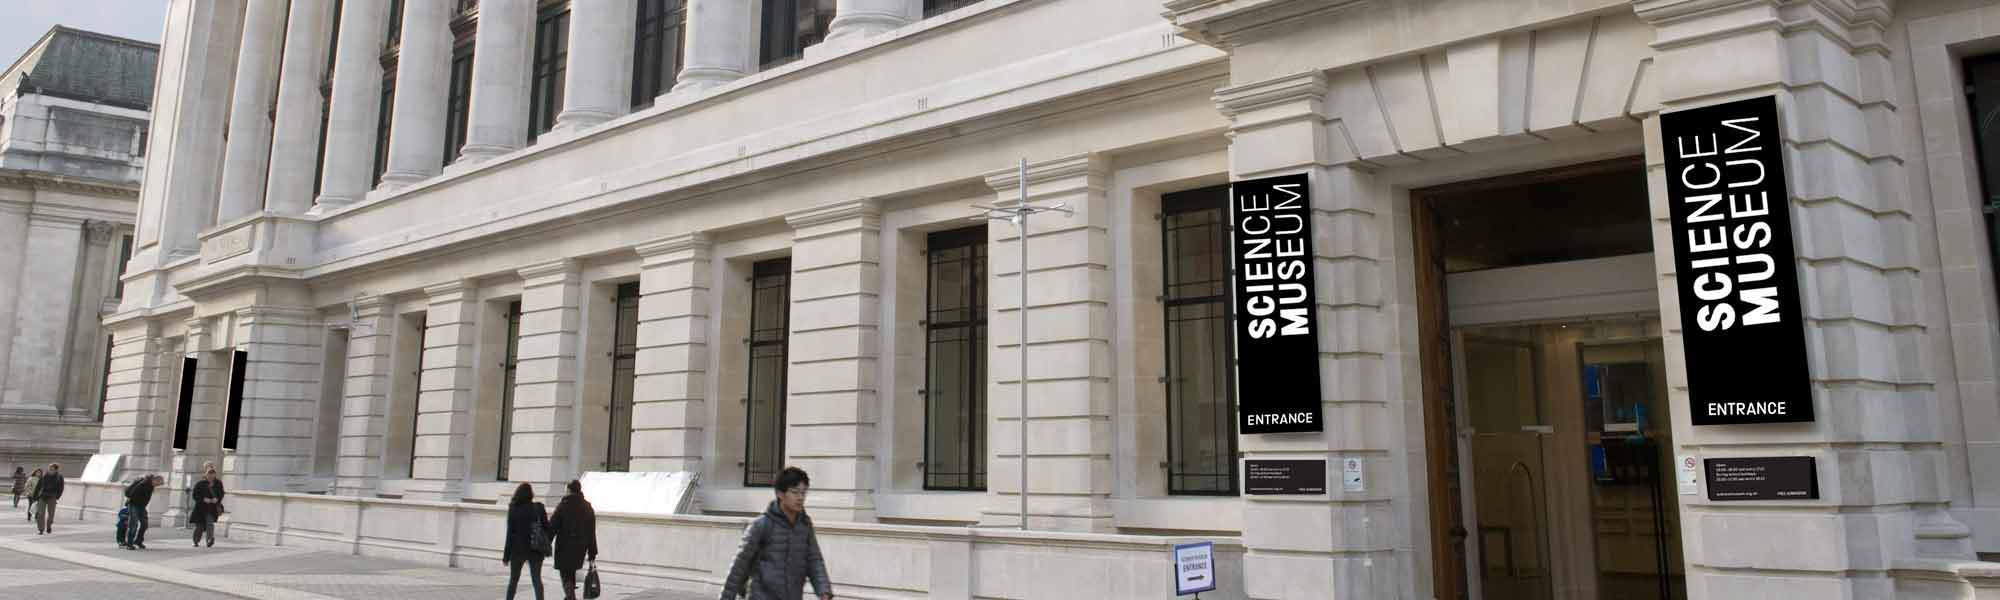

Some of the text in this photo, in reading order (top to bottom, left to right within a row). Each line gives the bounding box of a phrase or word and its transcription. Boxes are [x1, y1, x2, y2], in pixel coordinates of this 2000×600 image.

[1241, 193, 1277, 340] SCIENCE
[1272, 183, 1310, 337] MUSEUM
[1678, 132, 1736, 332] SCIENCE
[1721, 116, 1781, 326] MUSEUM
[1247, 412, 1313, 426] ENTRANCE
[1708, 401, 1787, 416] ENTRANCE
